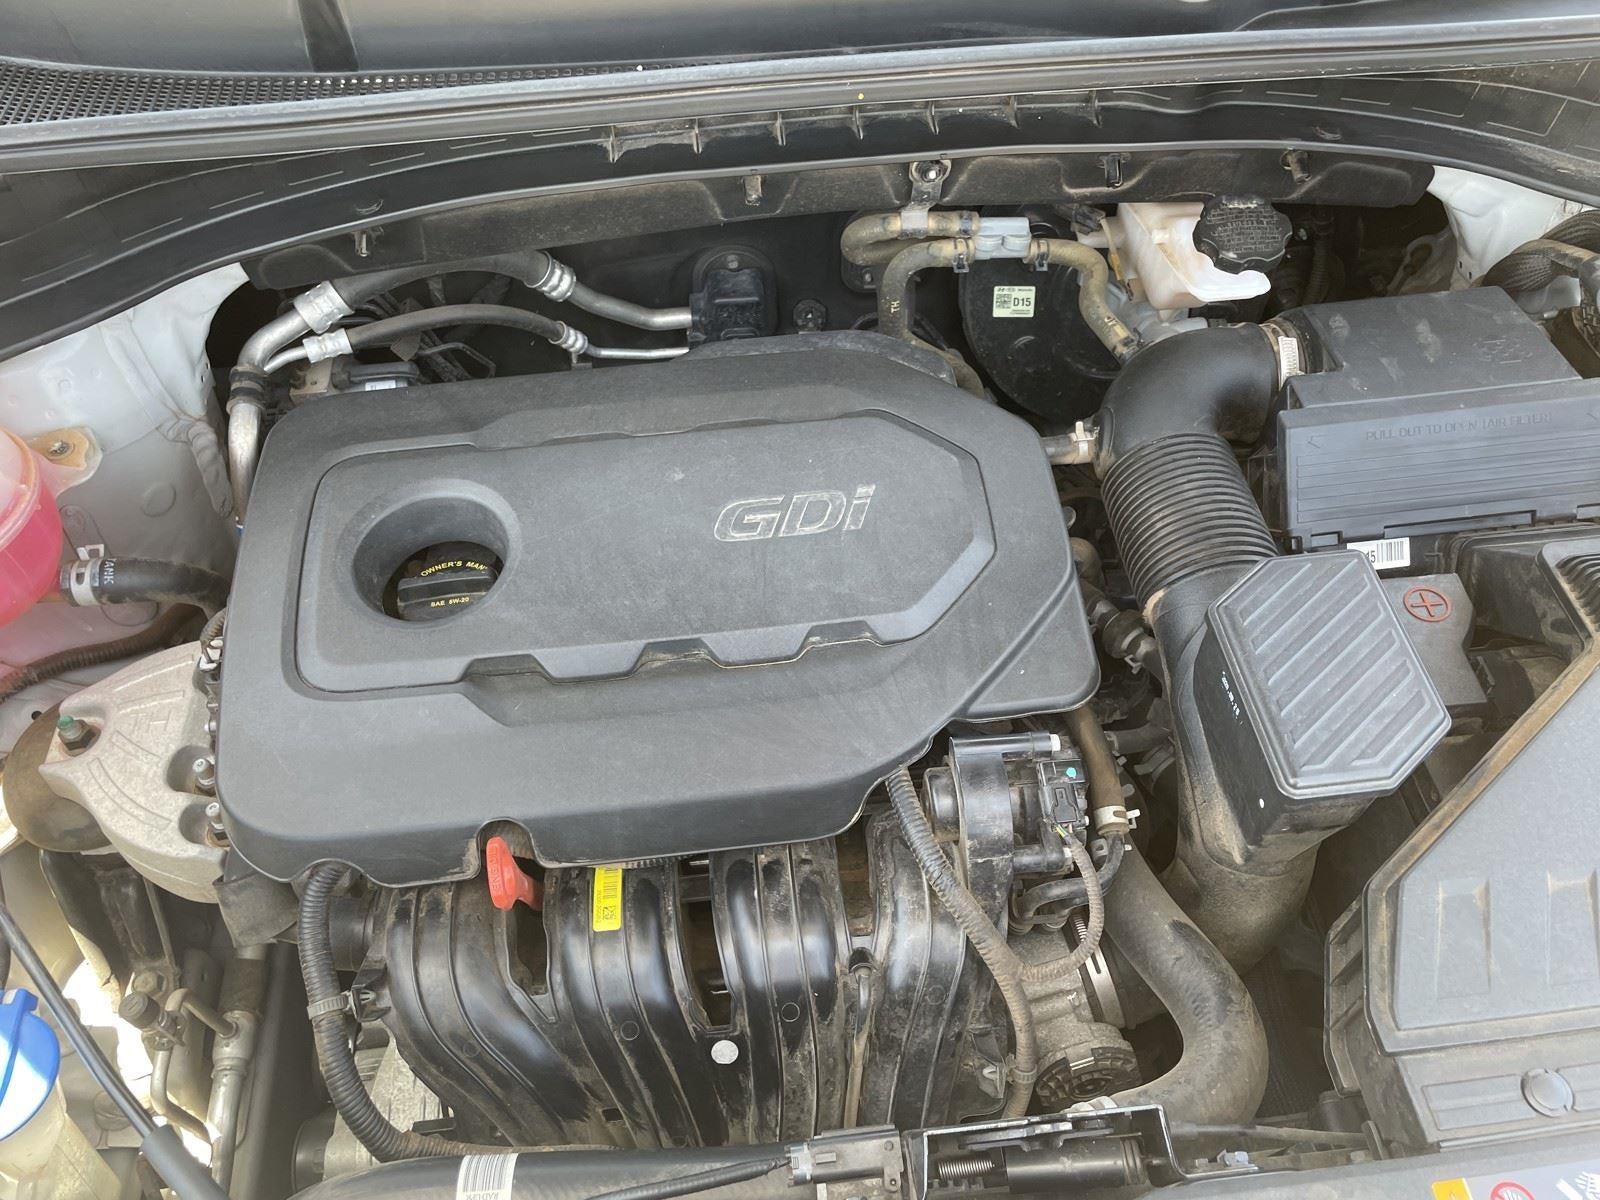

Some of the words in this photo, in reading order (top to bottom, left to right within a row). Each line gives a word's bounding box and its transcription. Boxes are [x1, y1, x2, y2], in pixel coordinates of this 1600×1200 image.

[1013, 297, 1031, 307] D15
[1365, 428, 1394, 441] PULL
[1399, 426, 1424, 438] OUT
[714, 484, 876, 542] GDi
[420, 560, 463, 577] OWNER'S
[430, 600, 446, 608] SAE
